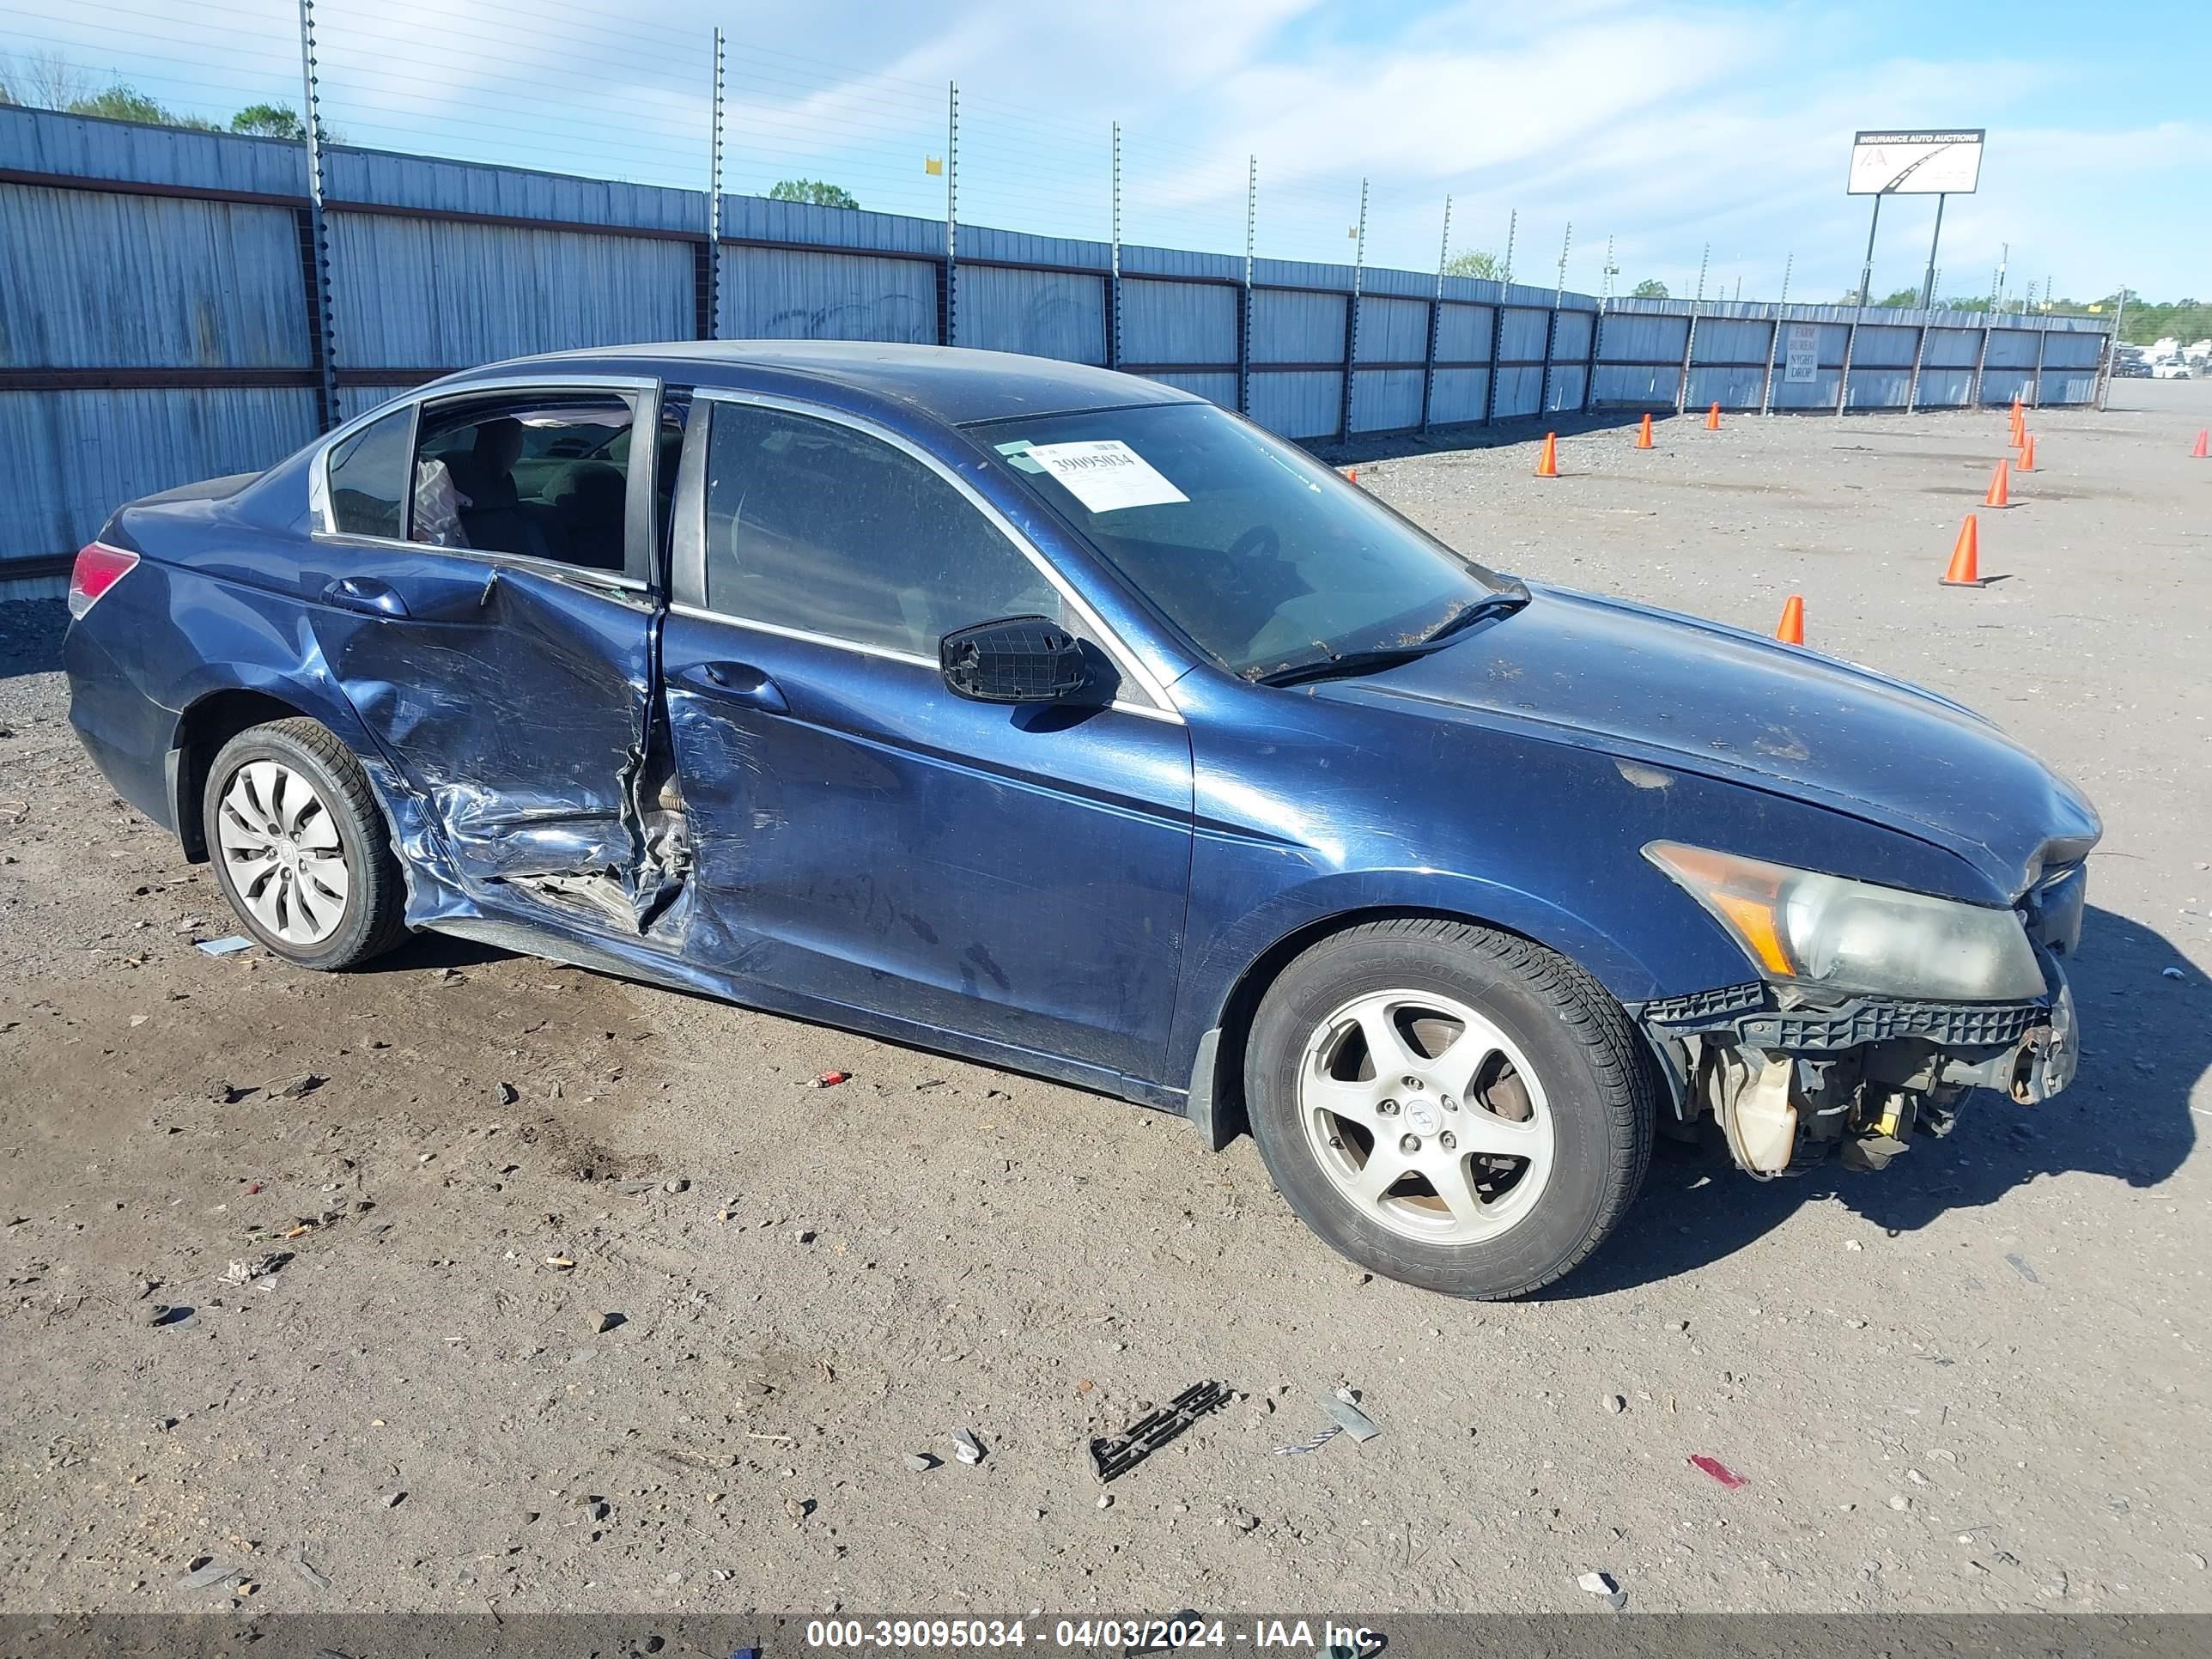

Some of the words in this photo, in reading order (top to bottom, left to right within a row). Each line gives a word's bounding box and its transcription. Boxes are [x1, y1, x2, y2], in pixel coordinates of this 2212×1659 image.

[1859, 135, 1909, 144] INSURANCE
[1909, 135, 1934, 144] AUTO
[1934, 133, 1979, 143] AUCTIONS
[1795, 326, 1814, 337] FARM
[1790, 355, 1814, 365] NIGHT
[1791, 367, 1813, 378] DROP
[1052, 453, 1135, 472] 39095034
